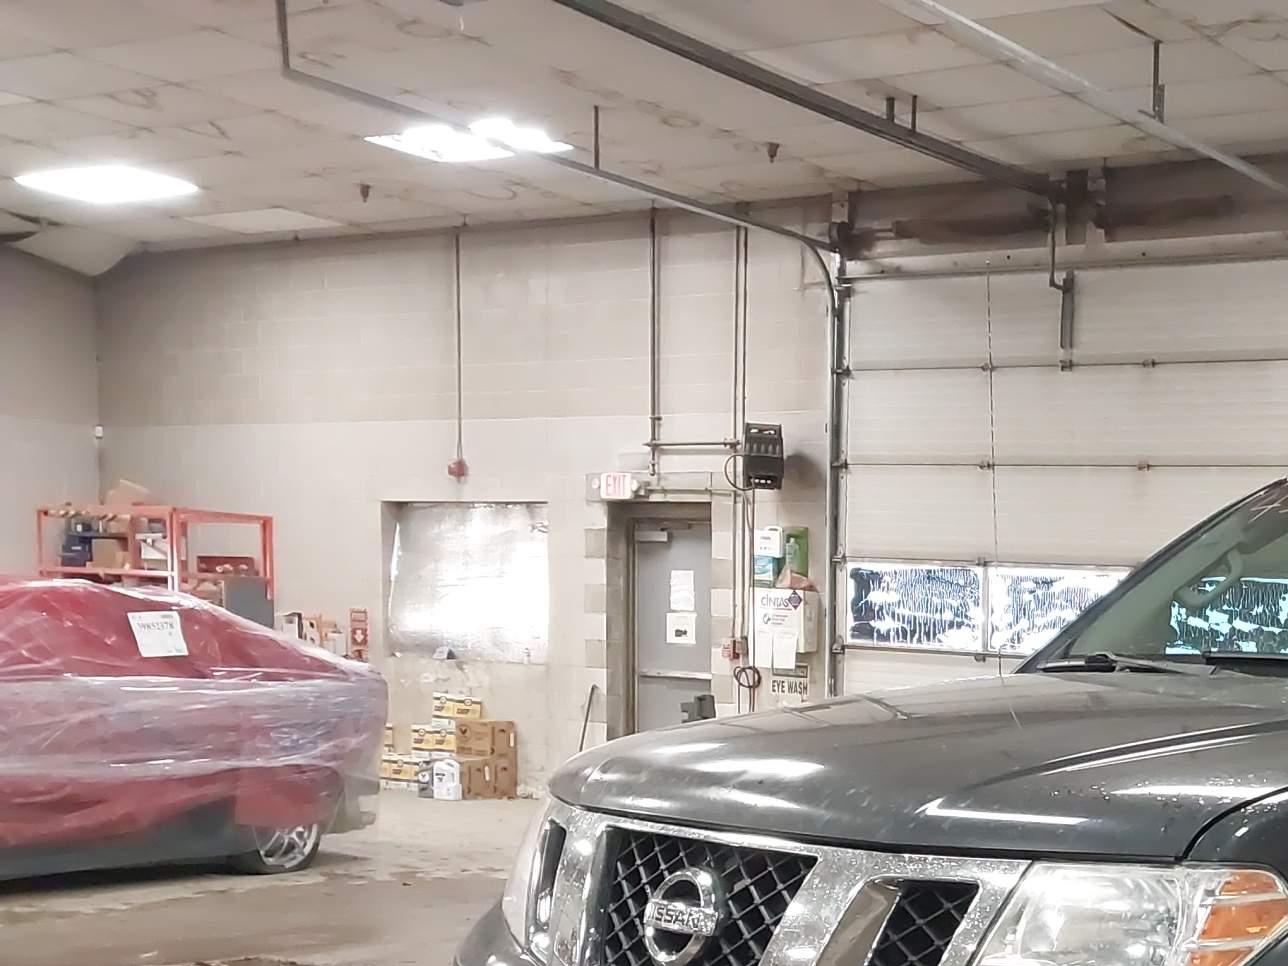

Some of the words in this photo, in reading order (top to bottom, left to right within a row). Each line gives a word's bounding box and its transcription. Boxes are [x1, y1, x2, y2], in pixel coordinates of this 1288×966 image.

[605, 474, 625, 497] EXIT
[761, 593, 789, 608] CINTAS
[772, 680, 785, 693] EYE
[787, 680, 808, 695] WASH
[646, 903, 701, 930] ISSAN
